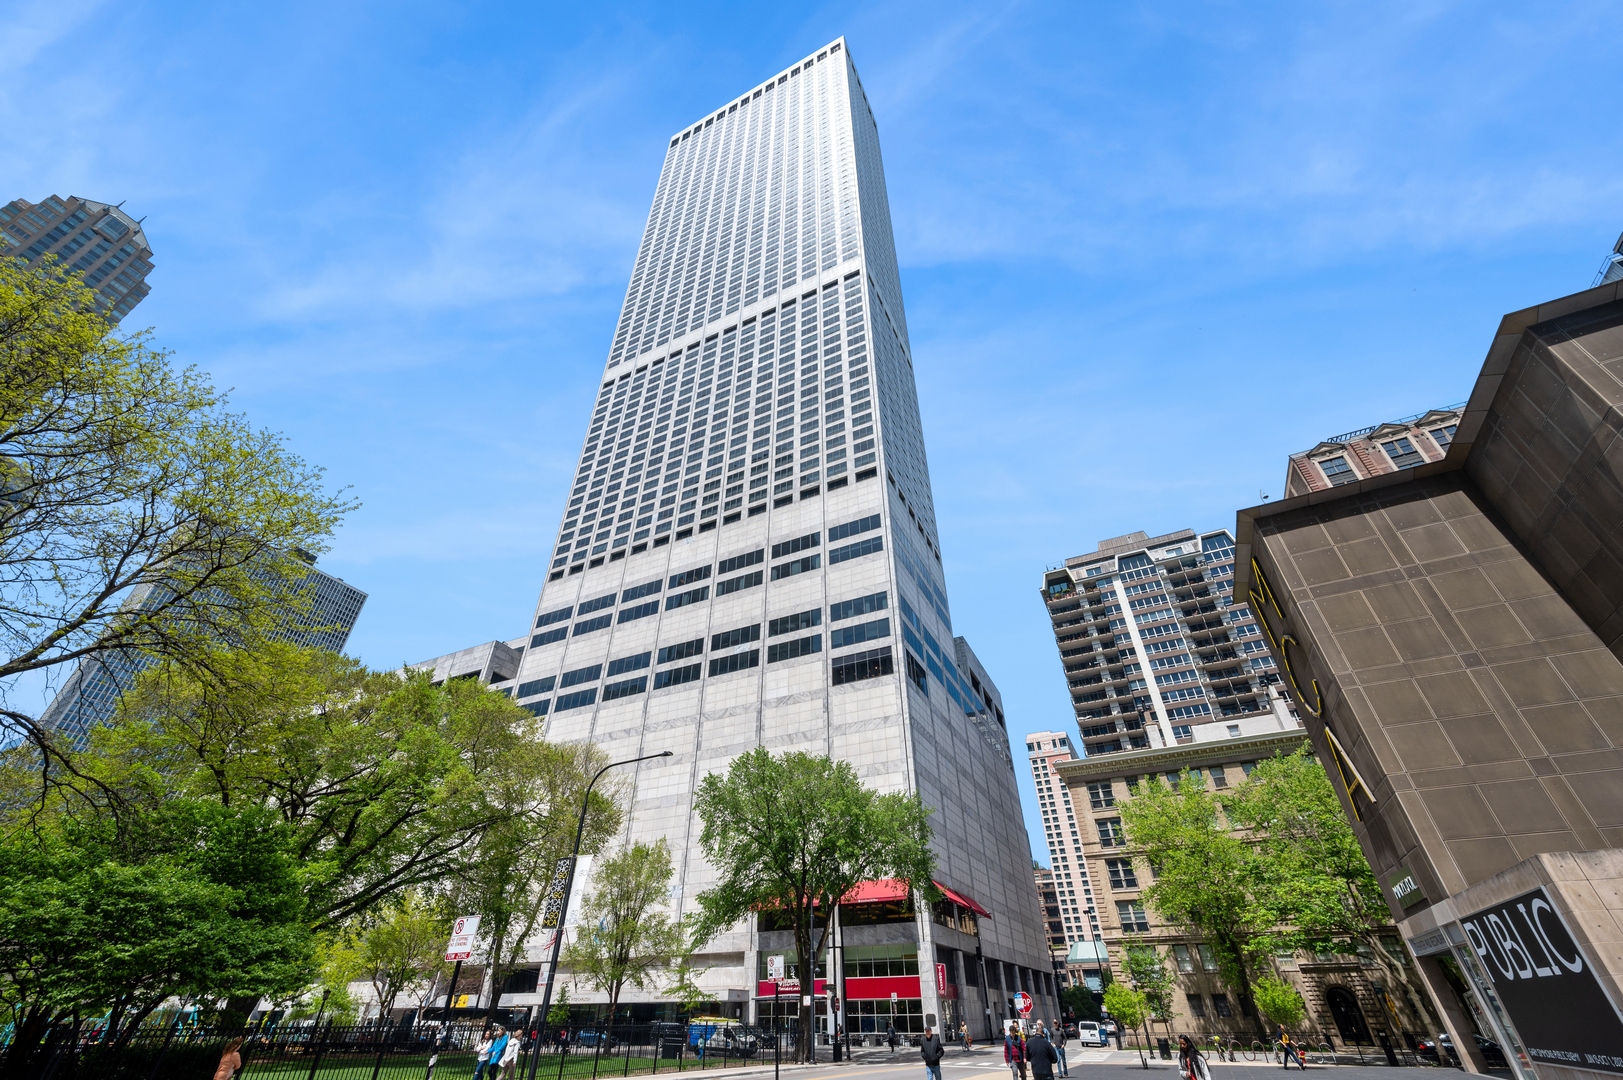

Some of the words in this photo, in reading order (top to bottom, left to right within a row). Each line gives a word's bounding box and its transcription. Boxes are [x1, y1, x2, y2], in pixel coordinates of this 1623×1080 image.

[1249, 555, 1377, 822] MCA
[543, 919, 557, 927] MCA
[1462, 898, 1583, 983] PUBLIC
